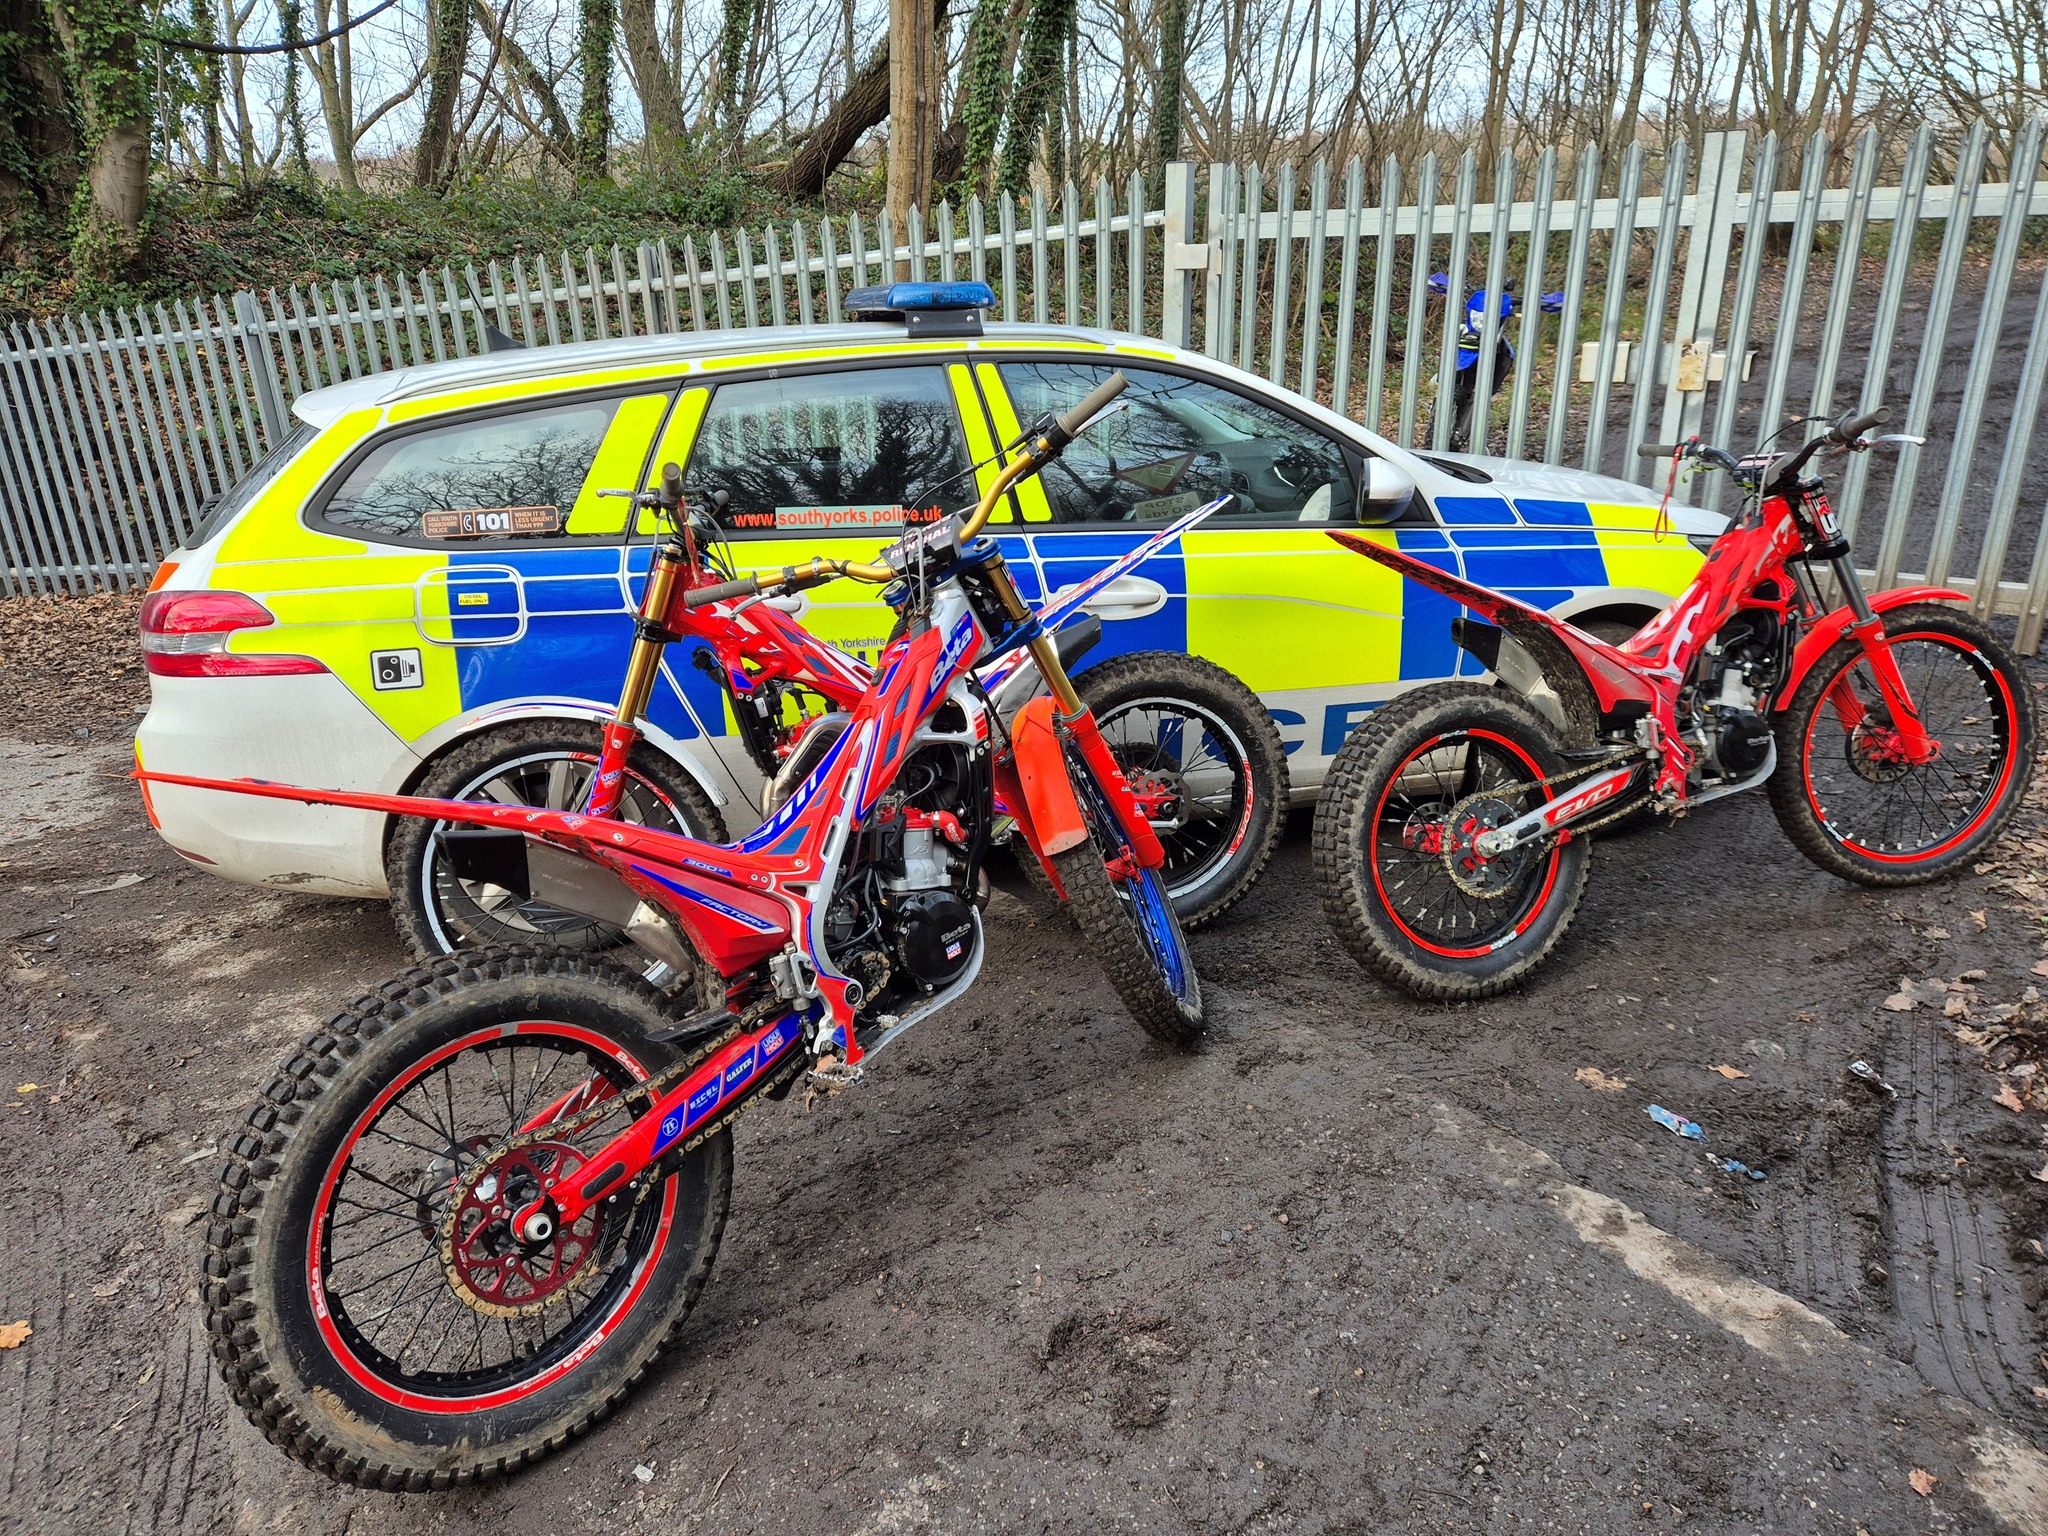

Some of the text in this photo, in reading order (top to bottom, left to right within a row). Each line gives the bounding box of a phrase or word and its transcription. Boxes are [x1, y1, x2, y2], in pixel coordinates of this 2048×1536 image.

[476, 512, 510, 530] 101
[733, 505, 943, 528] www.southyorks.police.uk
[840, 635, 886, 649] Yorkshire
[930, 627, 973, 693] Beta
[1554, 783, 1613, 821] EVO
[701, 898, 768, 927] FACTORY
[940, 923, 972, 943] Beta
[765, 1037, 784, 1056] MOLY
[615, 1050, 647, 1082] Beta
[663, 1117, 679, 1136] ZF
[311, 1266, 328, 1320] Beta
[563, 1332, 605, 1368] Beta
